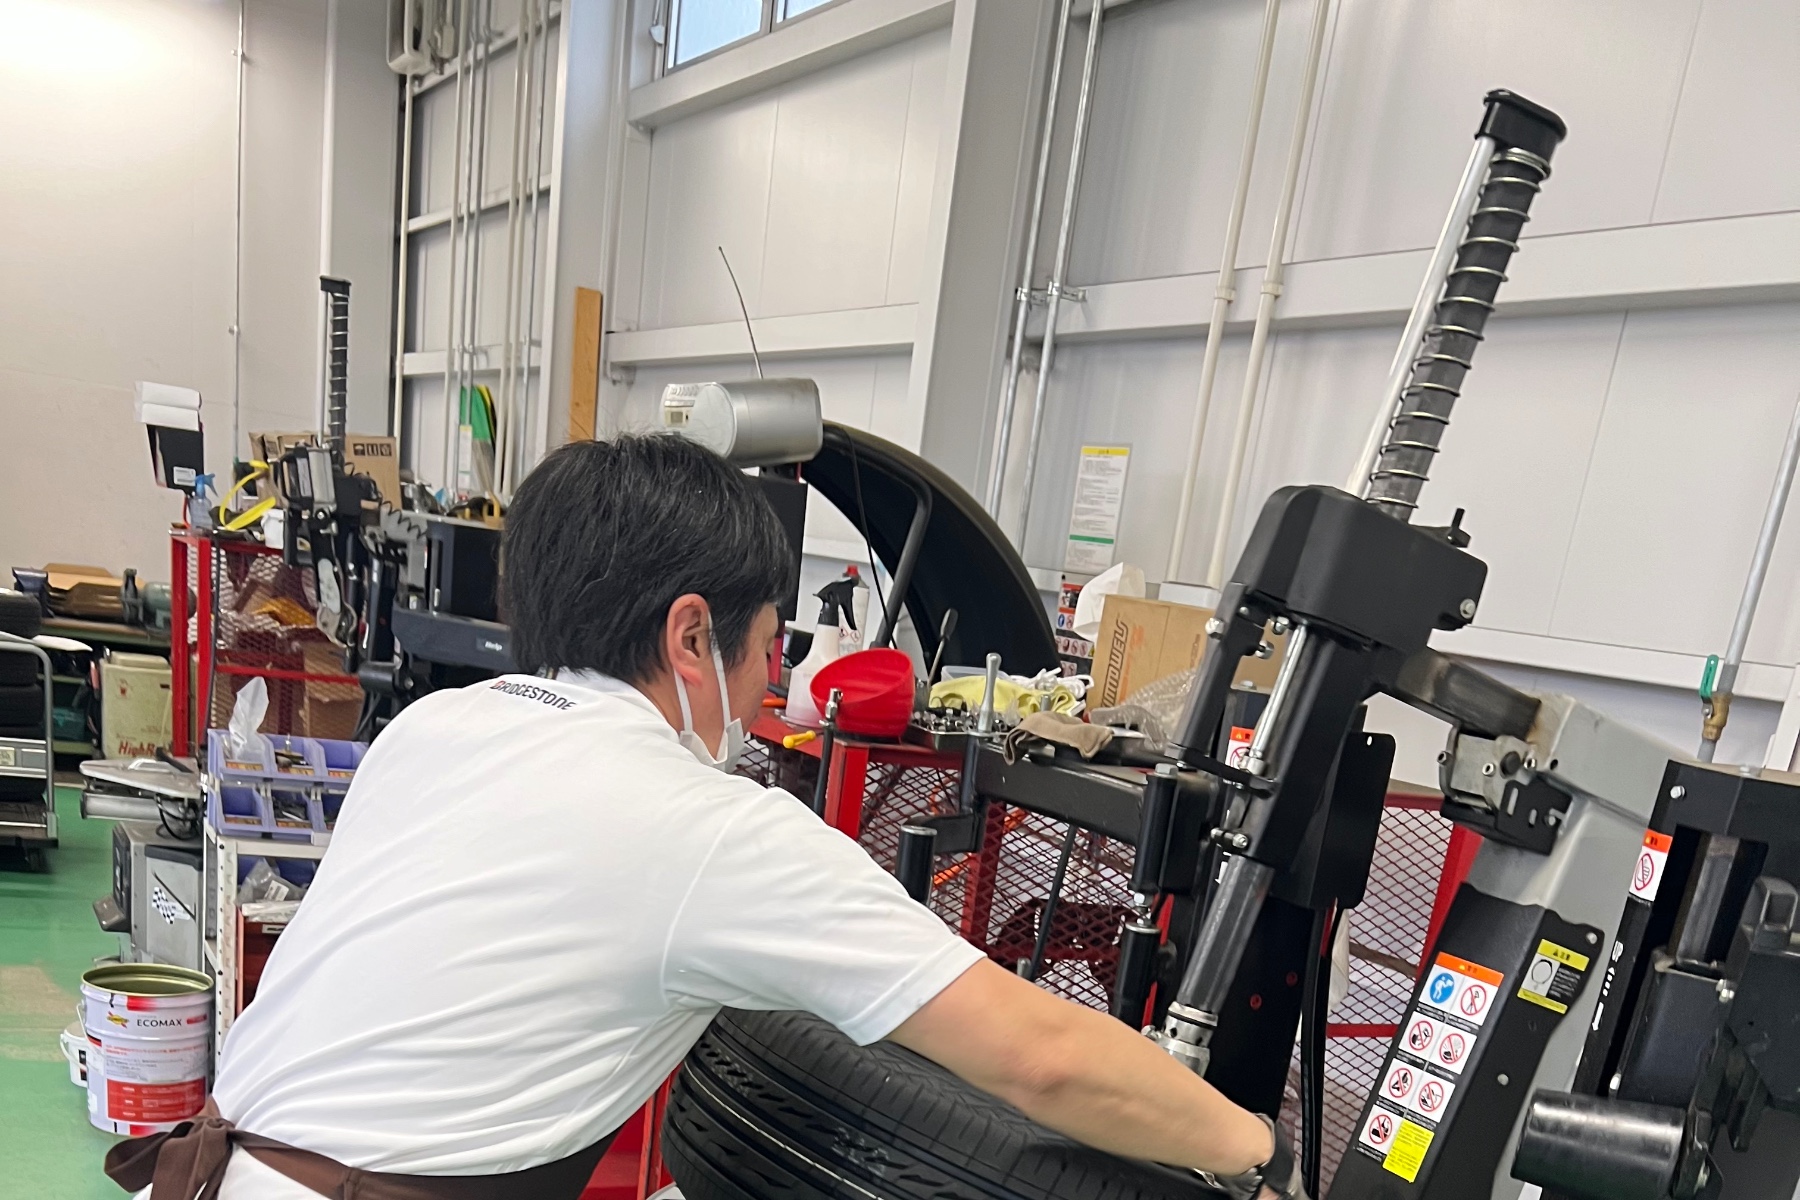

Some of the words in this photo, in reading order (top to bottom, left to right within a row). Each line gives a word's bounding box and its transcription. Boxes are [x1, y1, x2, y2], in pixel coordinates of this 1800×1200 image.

[1100, 618, 1128, 708] IMTOWELS
[489, 680, 577, 710] BRIDGESTONE
[137, 1018, 182, 1028] ECOMAX
